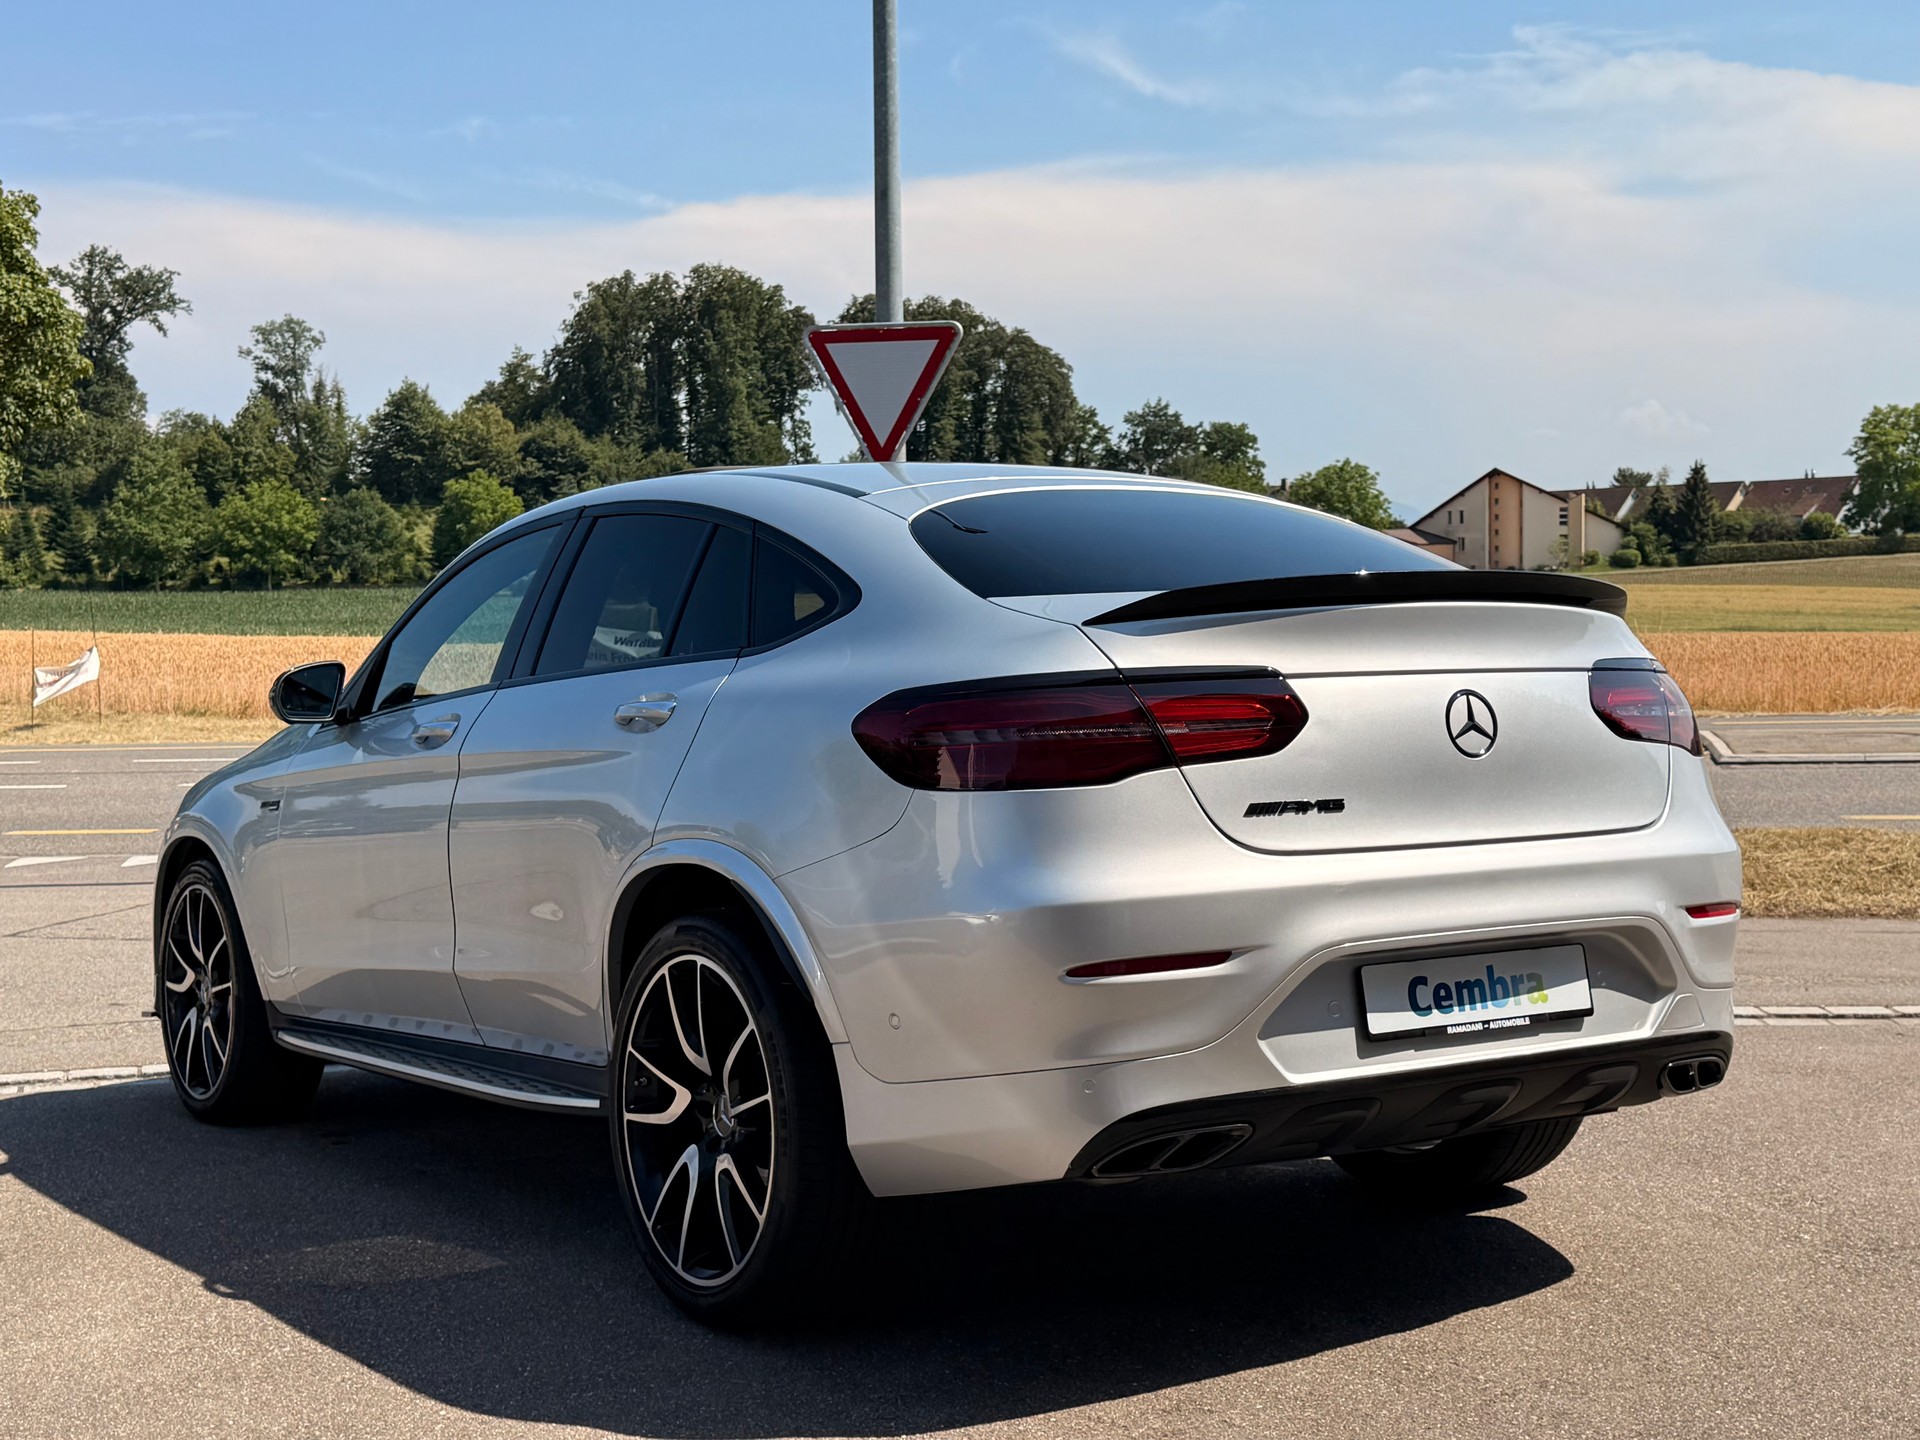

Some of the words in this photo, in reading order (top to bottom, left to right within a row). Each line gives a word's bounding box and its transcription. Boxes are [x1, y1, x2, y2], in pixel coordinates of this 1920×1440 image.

[1276, 798, 1345, 816] AMG
[1407, 964, 1549, 1017] Cembra
[1446, 1022, 1484, 1034] RAMADANI
[1489, 1017, 1531, 1030] AUTOMOBILE
